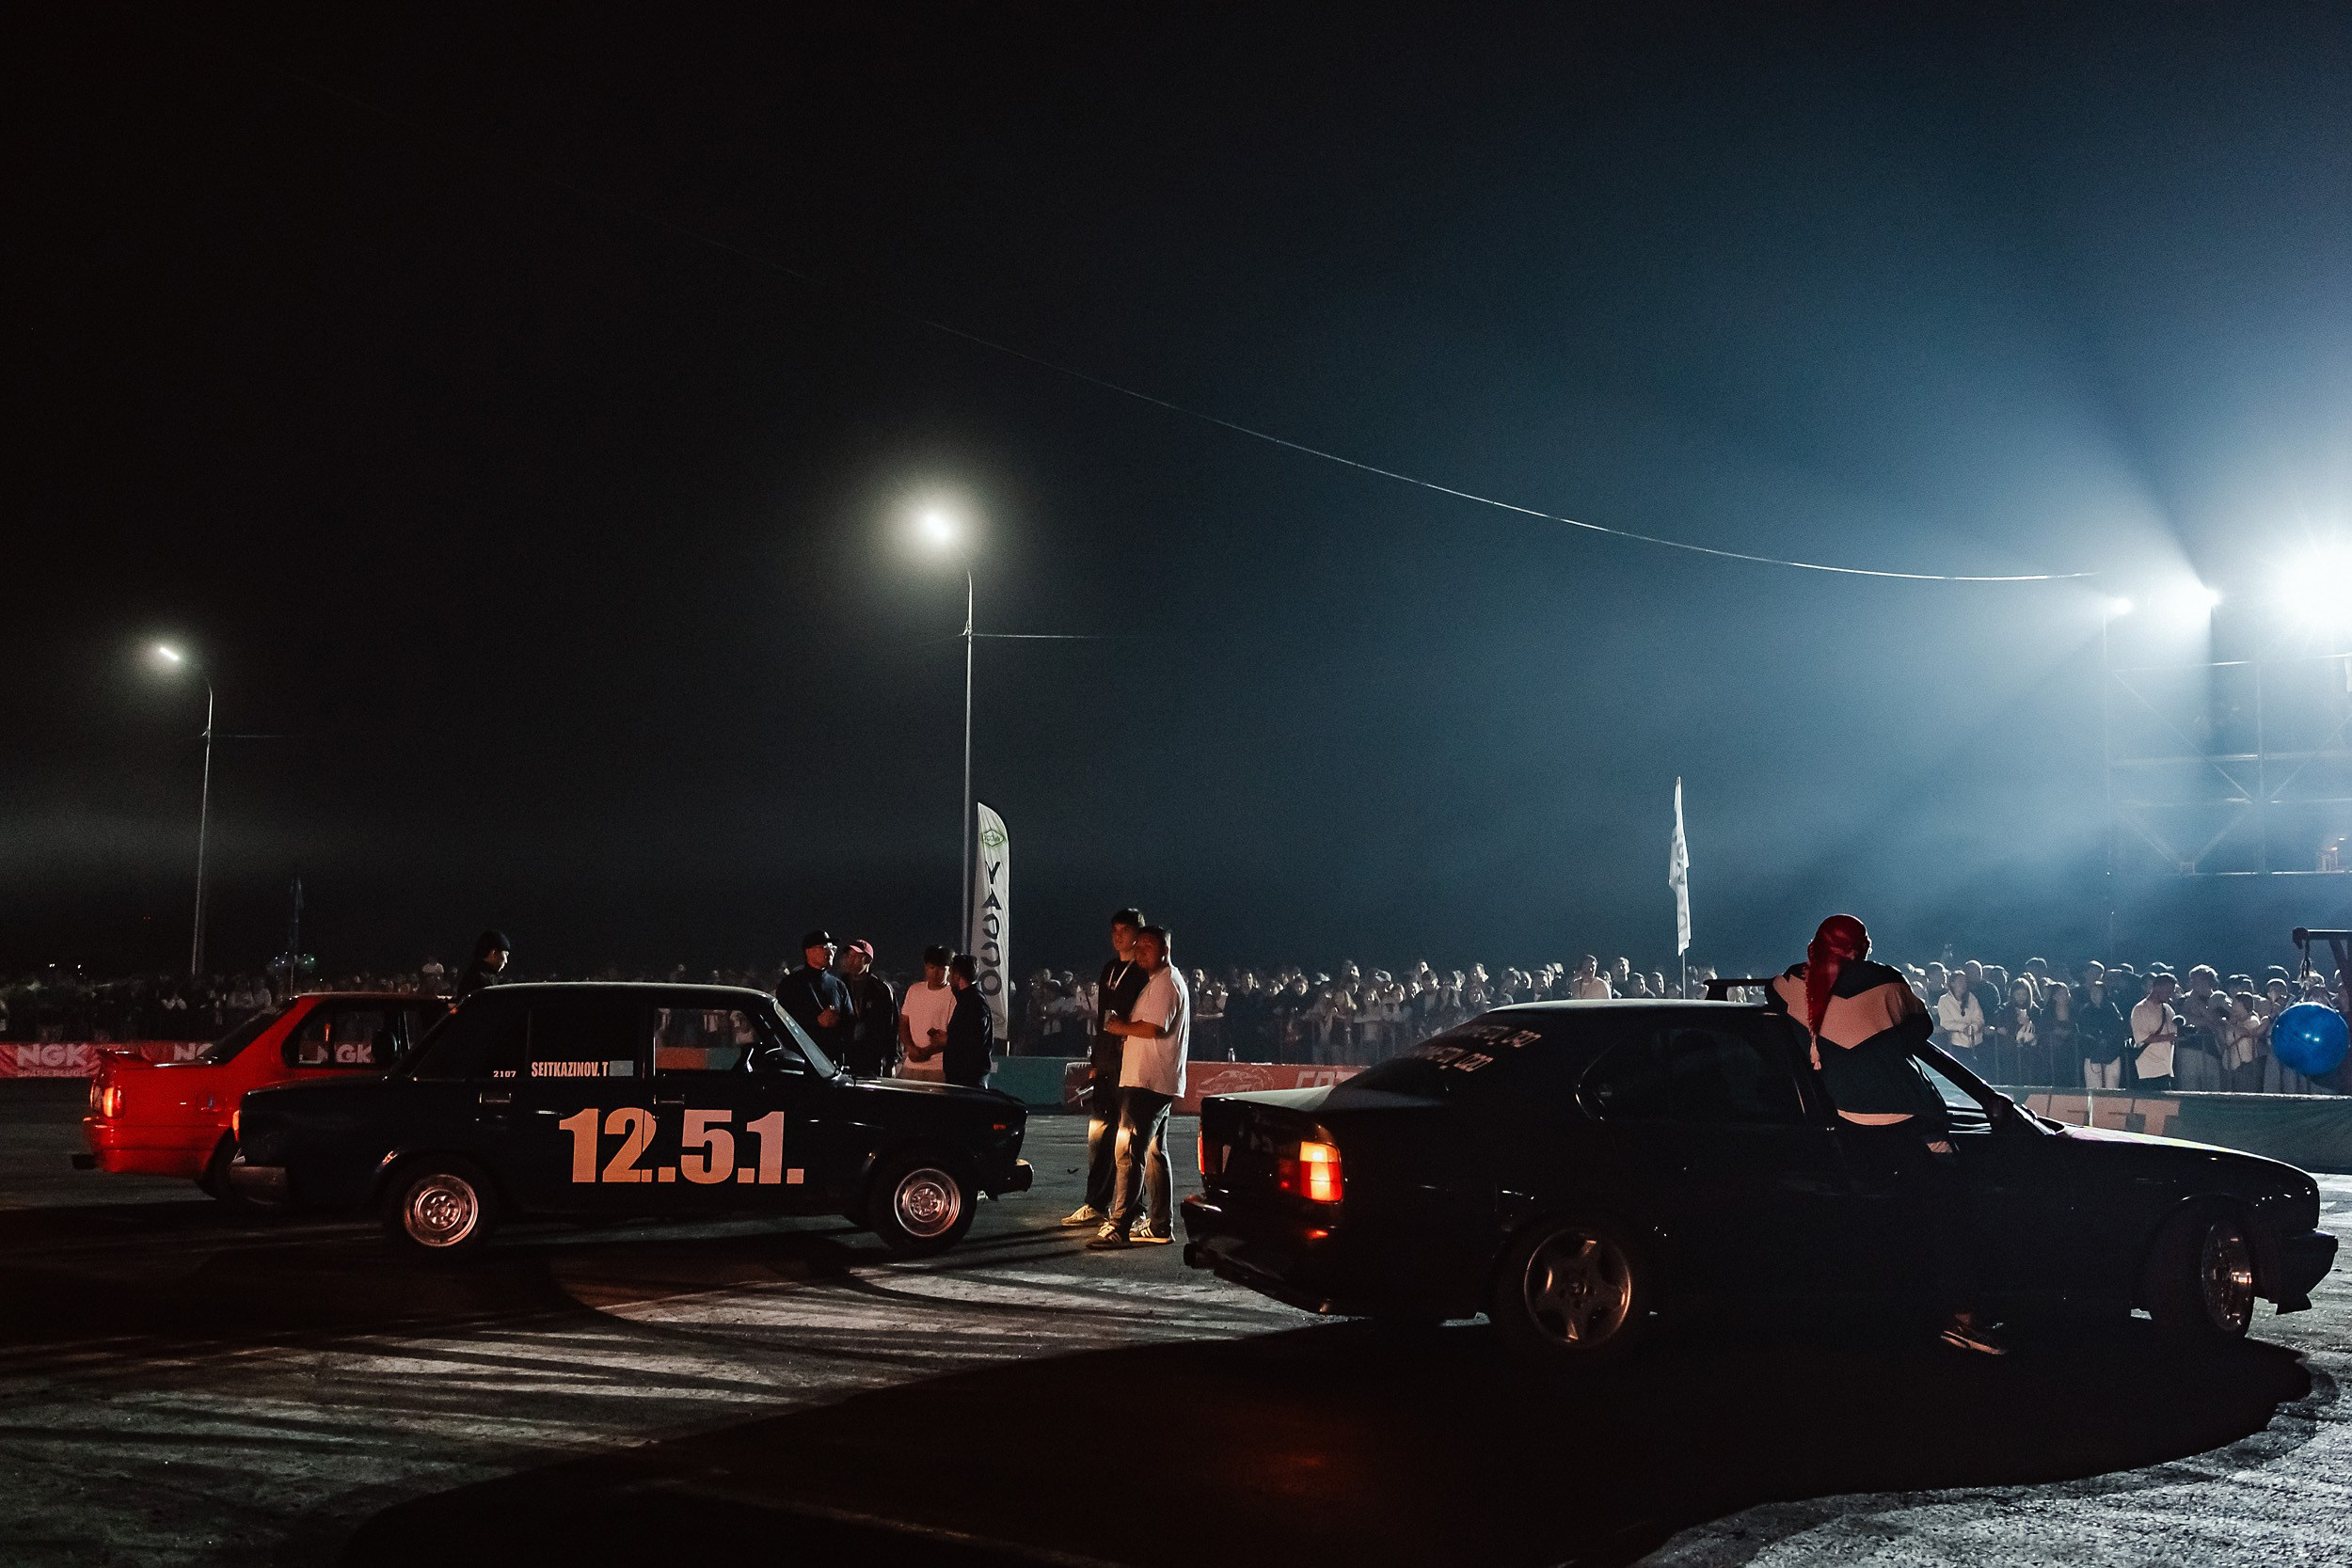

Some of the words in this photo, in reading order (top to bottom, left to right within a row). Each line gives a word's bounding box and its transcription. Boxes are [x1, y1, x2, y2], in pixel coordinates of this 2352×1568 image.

[17, 1043, 88, 1067] NGK
[493, 1069, 516, 1078] 2107
[531, 1061, 600, 1078] SEITKAZINOV.
[559, 1106, 805, 1185] 12.5.1.
